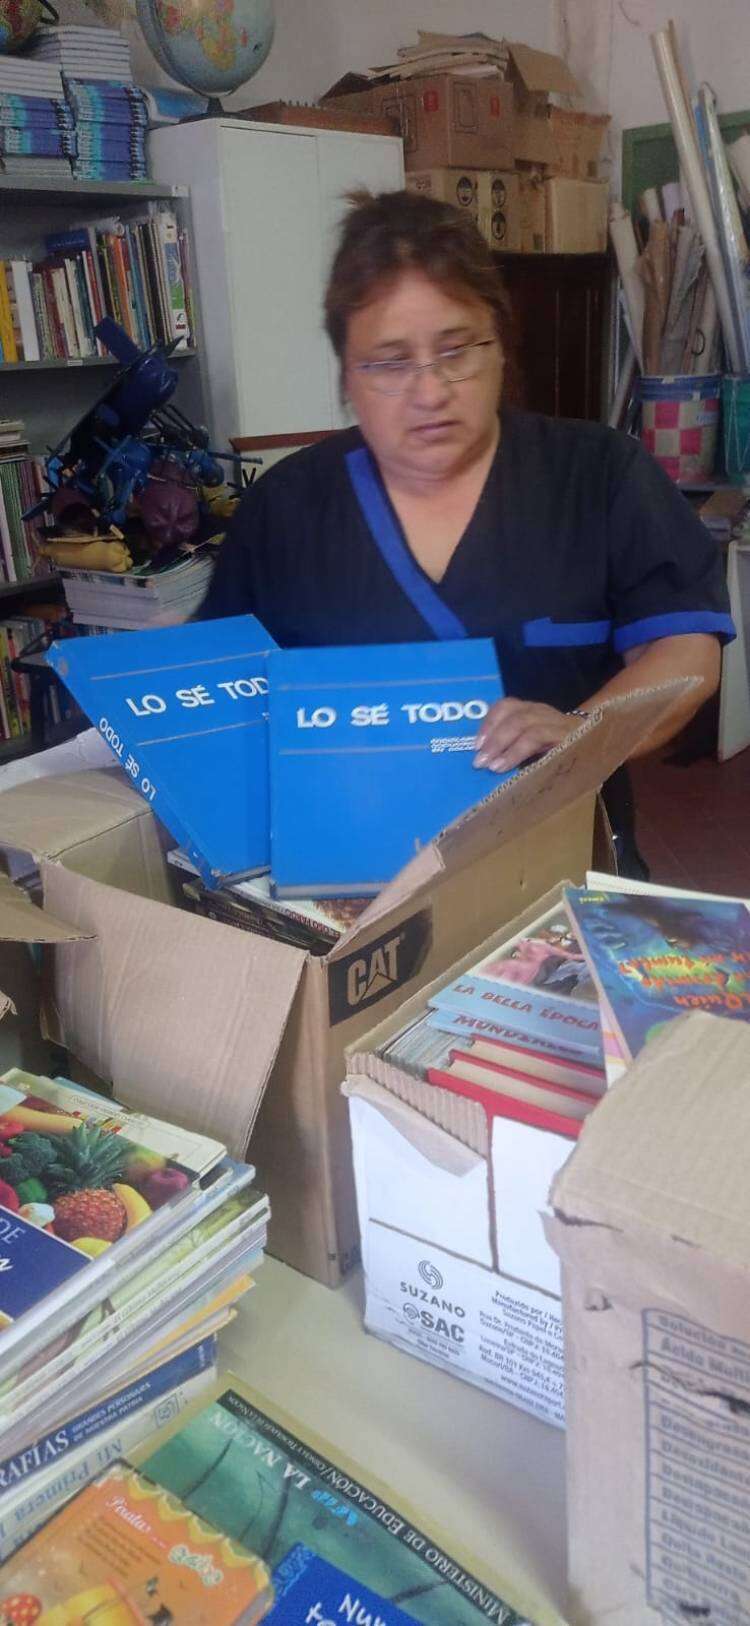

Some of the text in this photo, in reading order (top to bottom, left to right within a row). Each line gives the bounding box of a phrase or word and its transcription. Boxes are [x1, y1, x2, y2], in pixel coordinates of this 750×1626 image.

[126, 695, 167, 716] LO
[175, 685, 216, 708] SÉ
[296, 699, 489, 728] LO SÉ TODO
[99, 717, 156, 800] LO SÉ TODO
[347, 936, 401, 1006] CAT
[452, 983, 474, 995] LA
[480, 990, 533, 1013] BELLA
[400, 1281, 466, 1318] SUZANO
[419, 1310, 465, 1343] SAC
[15, 1438, 124, 1522] Mi Primera
[282, 1463, 312, 1490] LA
[404, 1531, 427, 1552] DE
[425, 1549, 513, 1625] MINISTERIO
